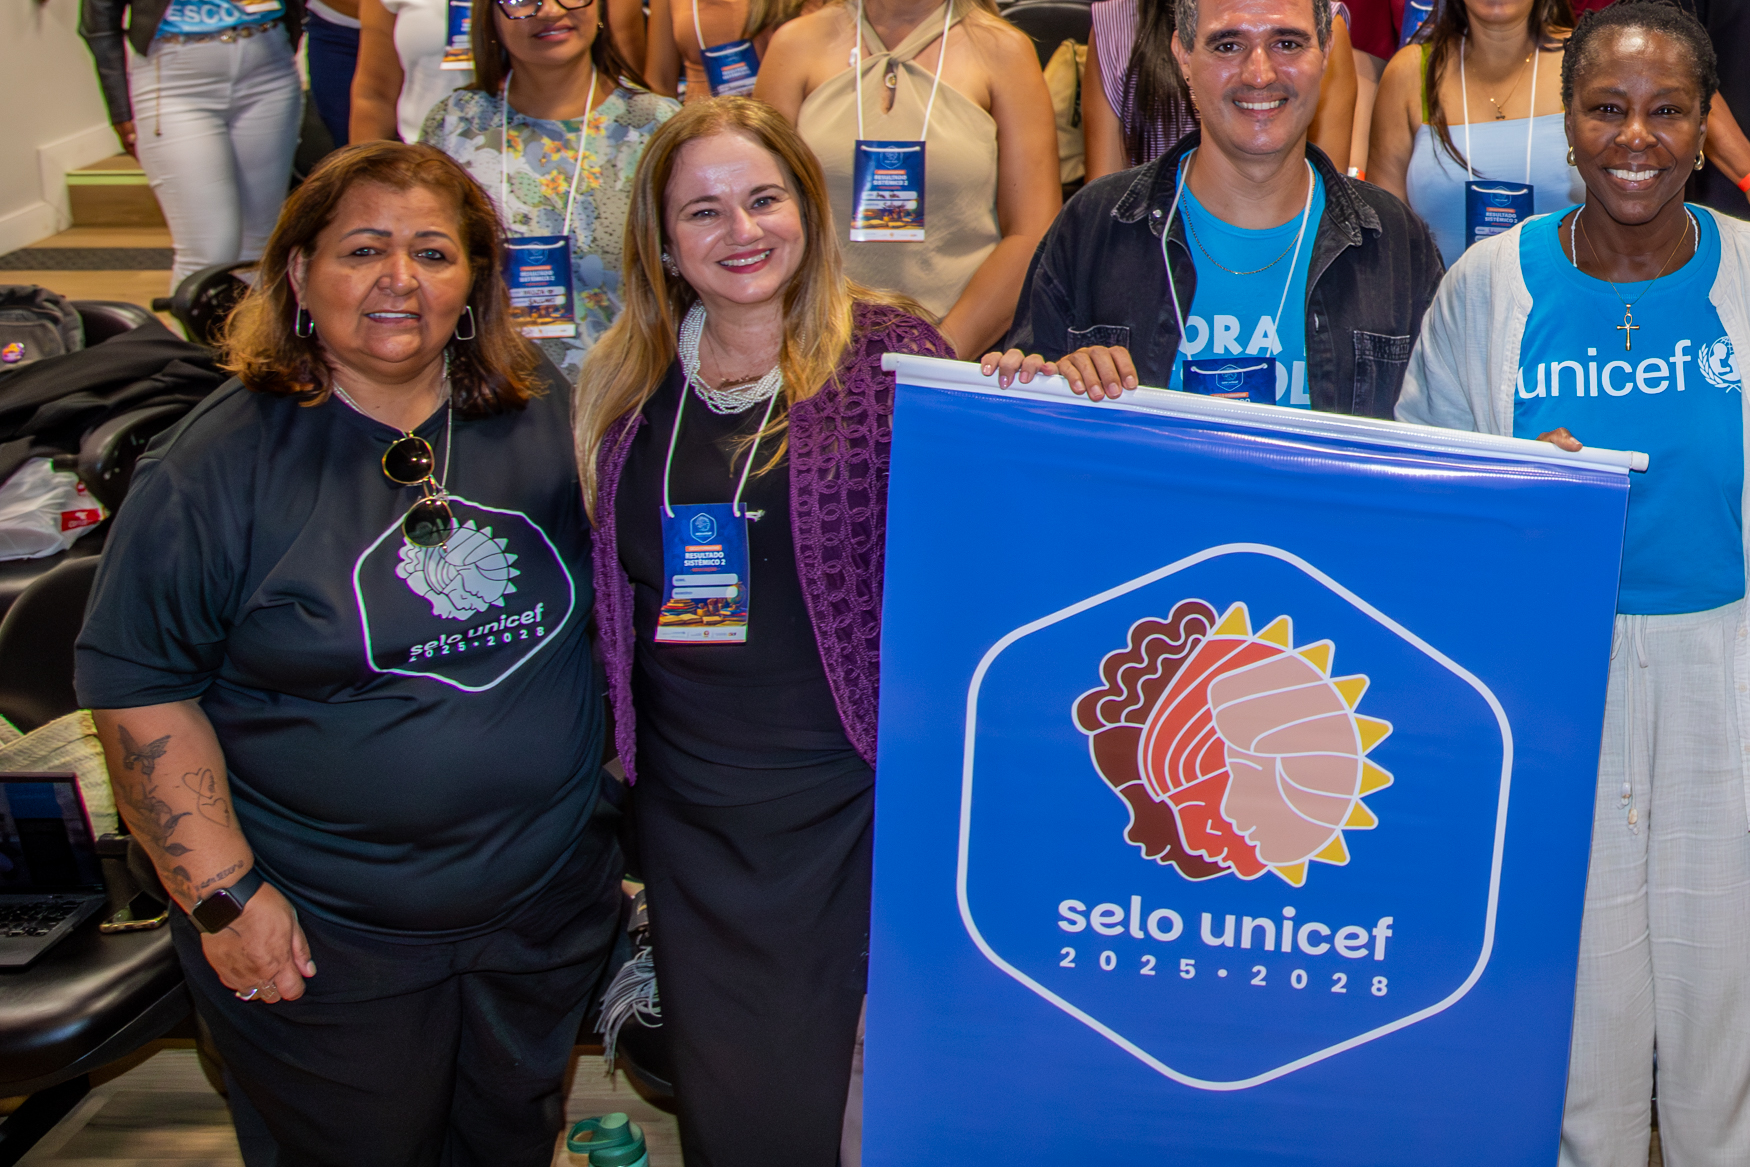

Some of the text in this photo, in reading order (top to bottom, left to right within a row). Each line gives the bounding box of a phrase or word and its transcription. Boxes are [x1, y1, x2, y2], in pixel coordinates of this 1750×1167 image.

[1178, 314, 1283, 356] ORA
[1516, 339, 1692, 399] unicef
[684, 551, 725, 559] RESULTADO
[409, 602, 545, 656] selo unicef
[1057, 895, 1394, 961] selo unicef
